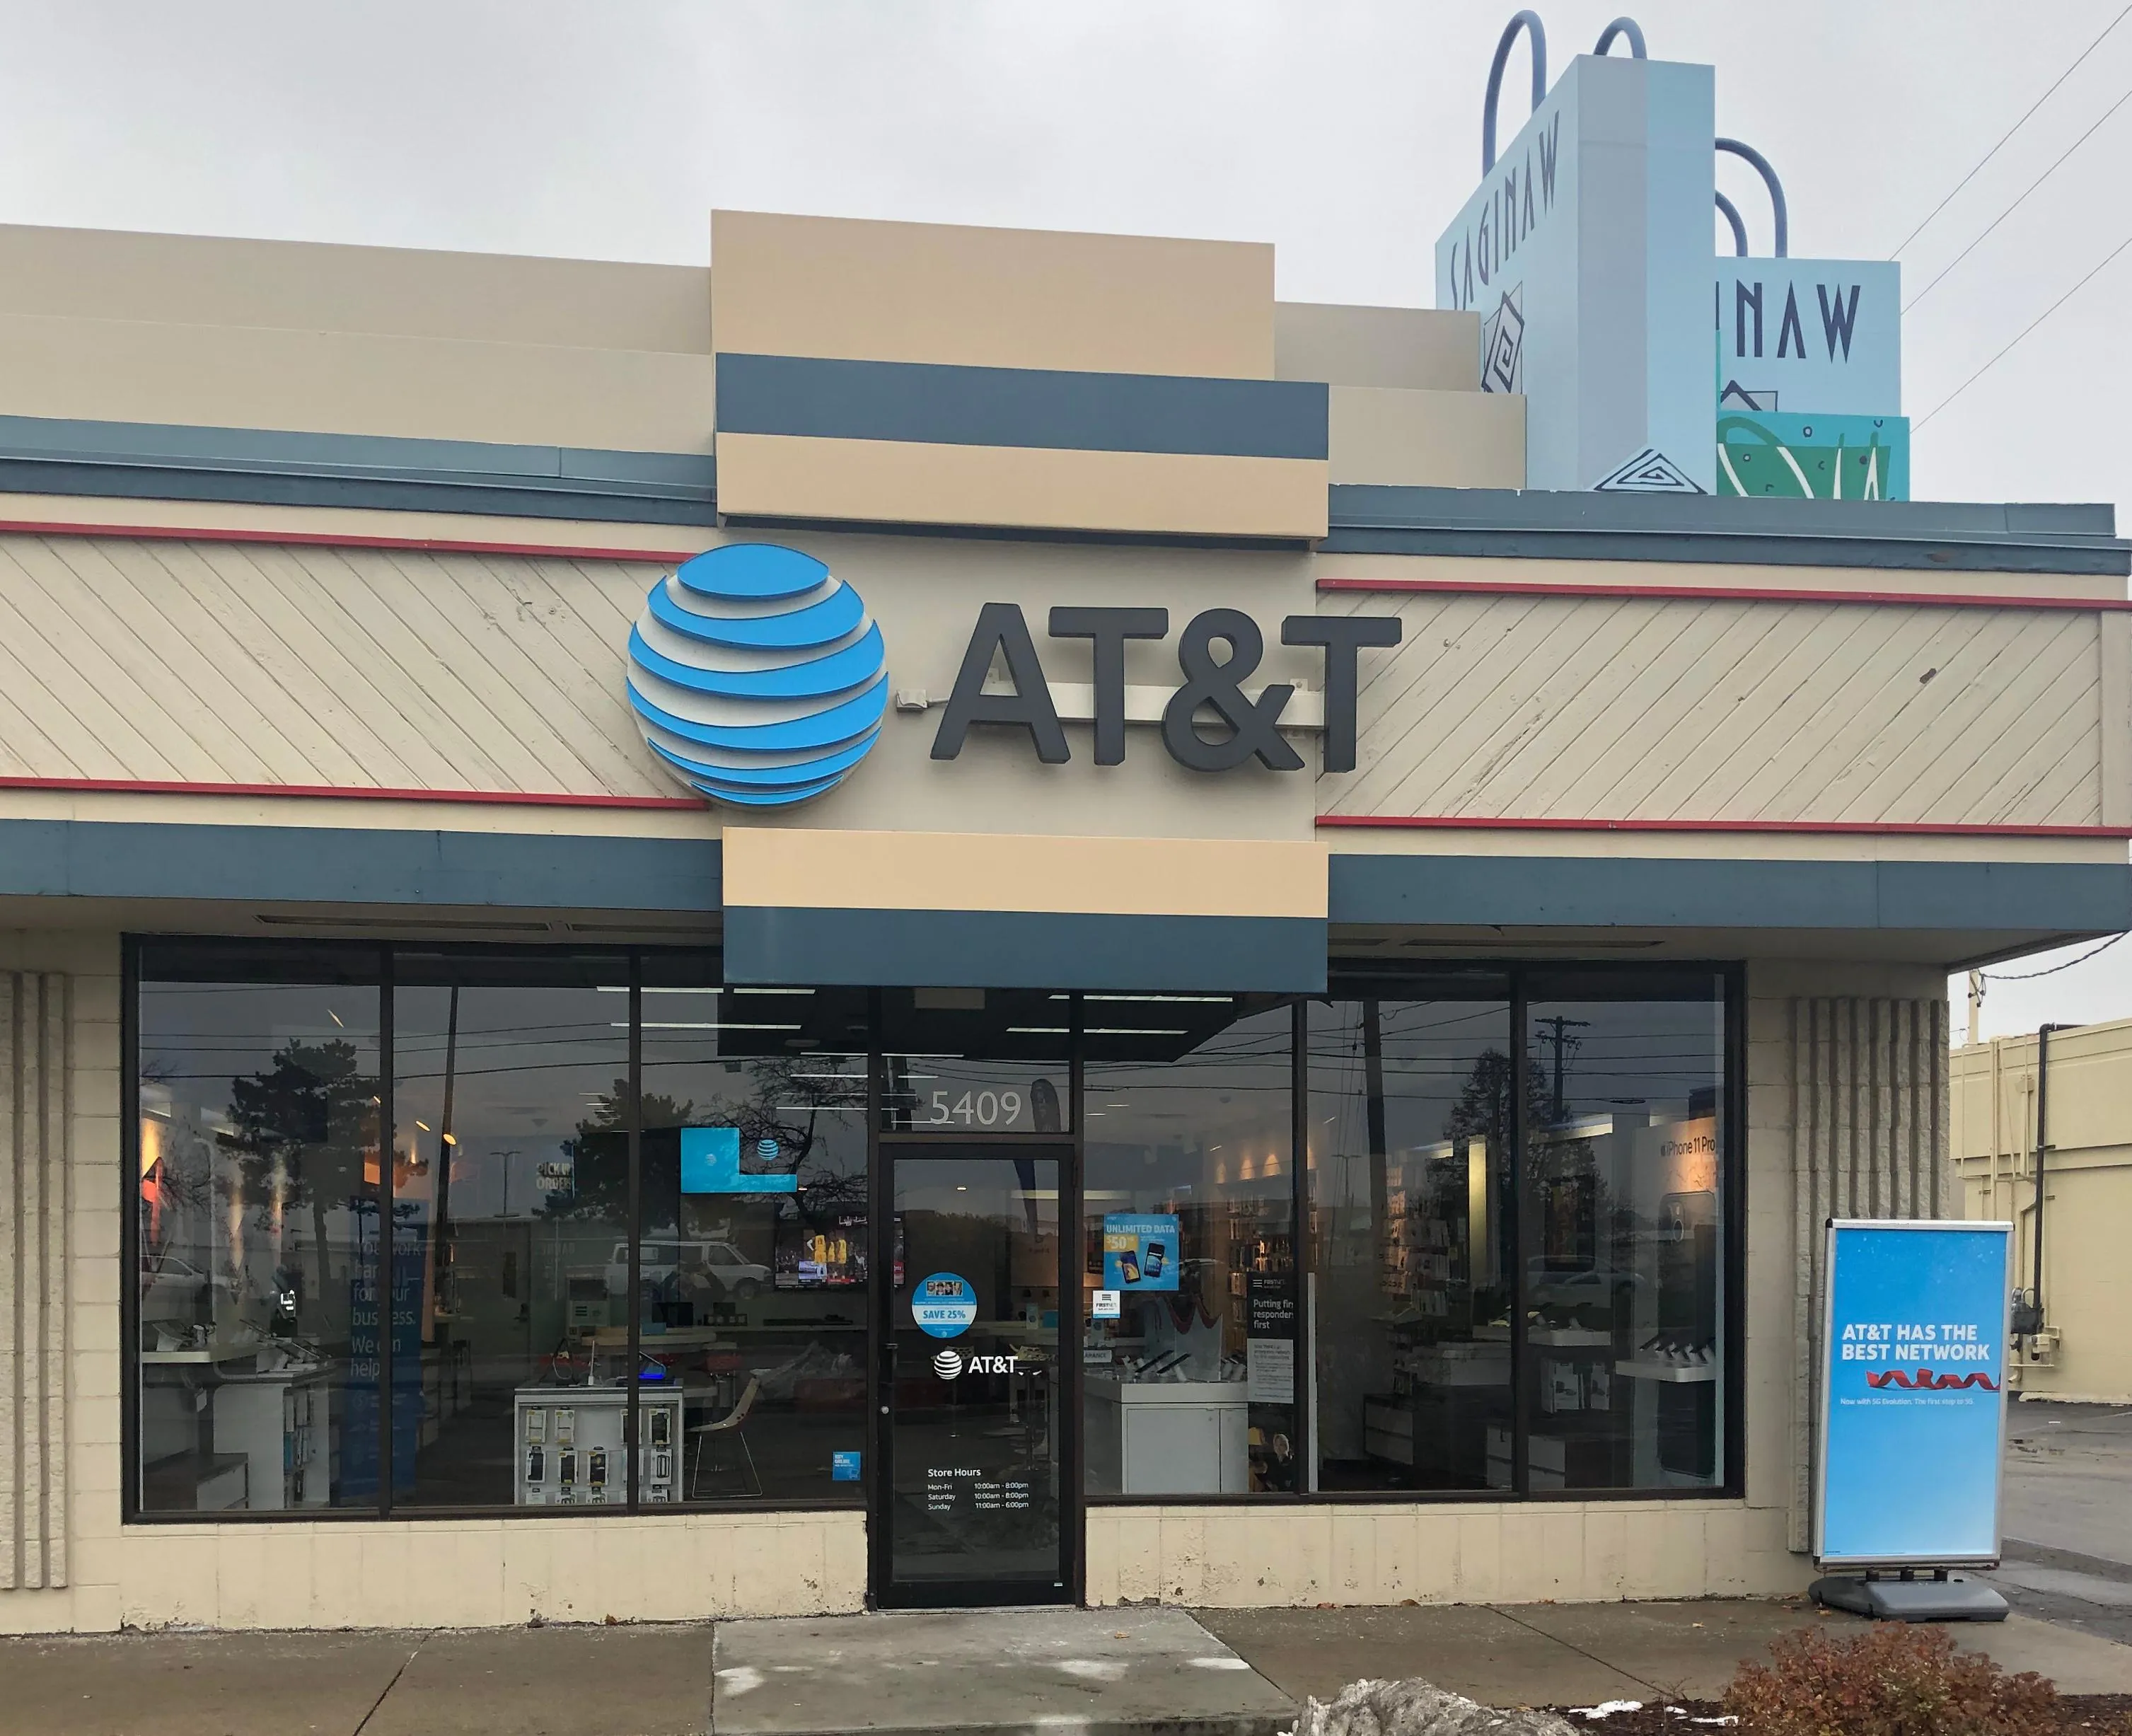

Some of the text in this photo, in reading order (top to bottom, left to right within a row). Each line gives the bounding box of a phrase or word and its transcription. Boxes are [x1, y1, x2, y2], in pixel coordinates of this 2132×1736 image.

[1451, 109, 1559, 311] SAGINAW
[1715, 279, 1861, 364] NAW
[931, 602, 1402, 774] AT&T
[930, 1090, 1021, 1125] 5409
[1667, 1136, 1715, 1155] iPhone 11 Pro
[1106, 1225, 1176, 1234] UNLIMITED DATA
[355, 1259, 380, 1279] har
[354, 1283, 376, 1302] for
[1253, 1299, 1282, 1309] Putting
[352, 1307, 416, 1326] busess.
[923, 1310, 966, 1319] SAVE 25%
[1253, 1320, 1270, 1329] first
[1842, 1324, 1978, 1341] AT&T HAS THE
[352, 1336, 374, 1353] We
[1842, 1343, 1990, 1360] BEST NETWORK
[968, 1355, 1019, 1374] AT&T
[927, 1468, 982, 1477] Store Hours
[1005, 1502, 1029, 1510] 6:00pm
